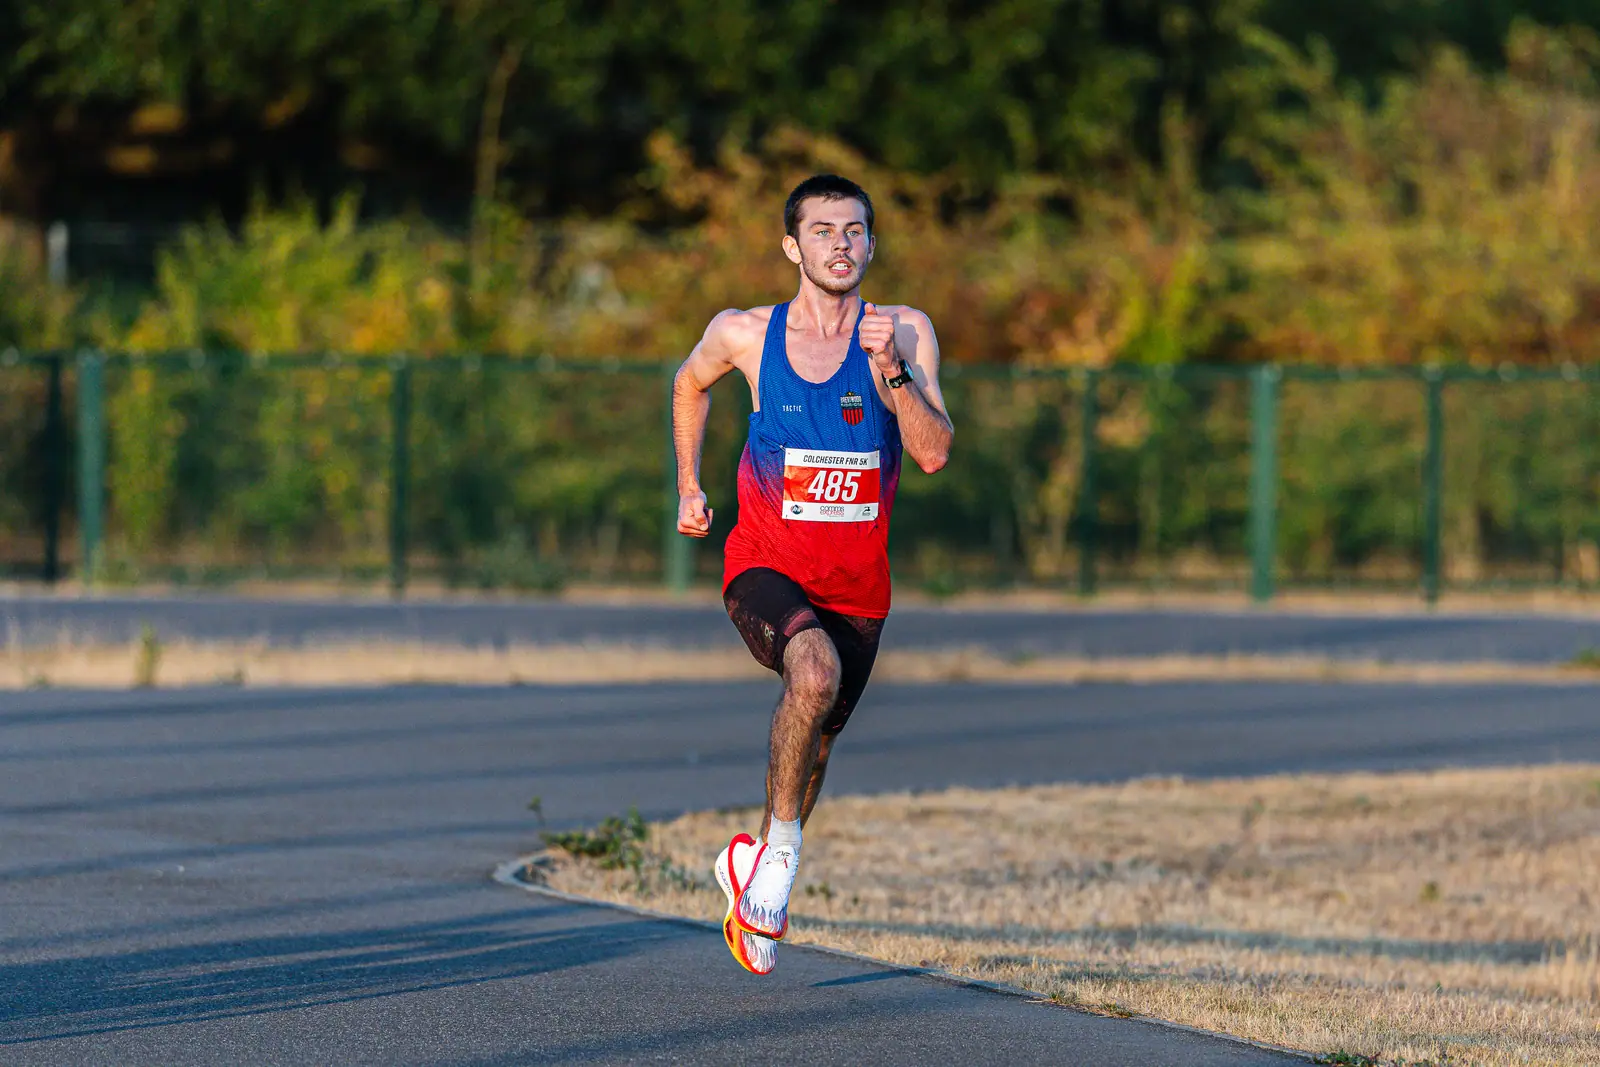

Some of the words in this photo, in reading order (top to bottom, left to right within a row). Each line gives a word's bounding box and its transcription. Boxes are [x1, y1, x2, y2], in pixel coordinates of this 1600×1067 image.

[803, 455, 844, 465] COLCHESTER
[845, 458, 859, 466] FNR
[859, 458, 869, 466] 5K
[808, 470, 861, 502] 485
